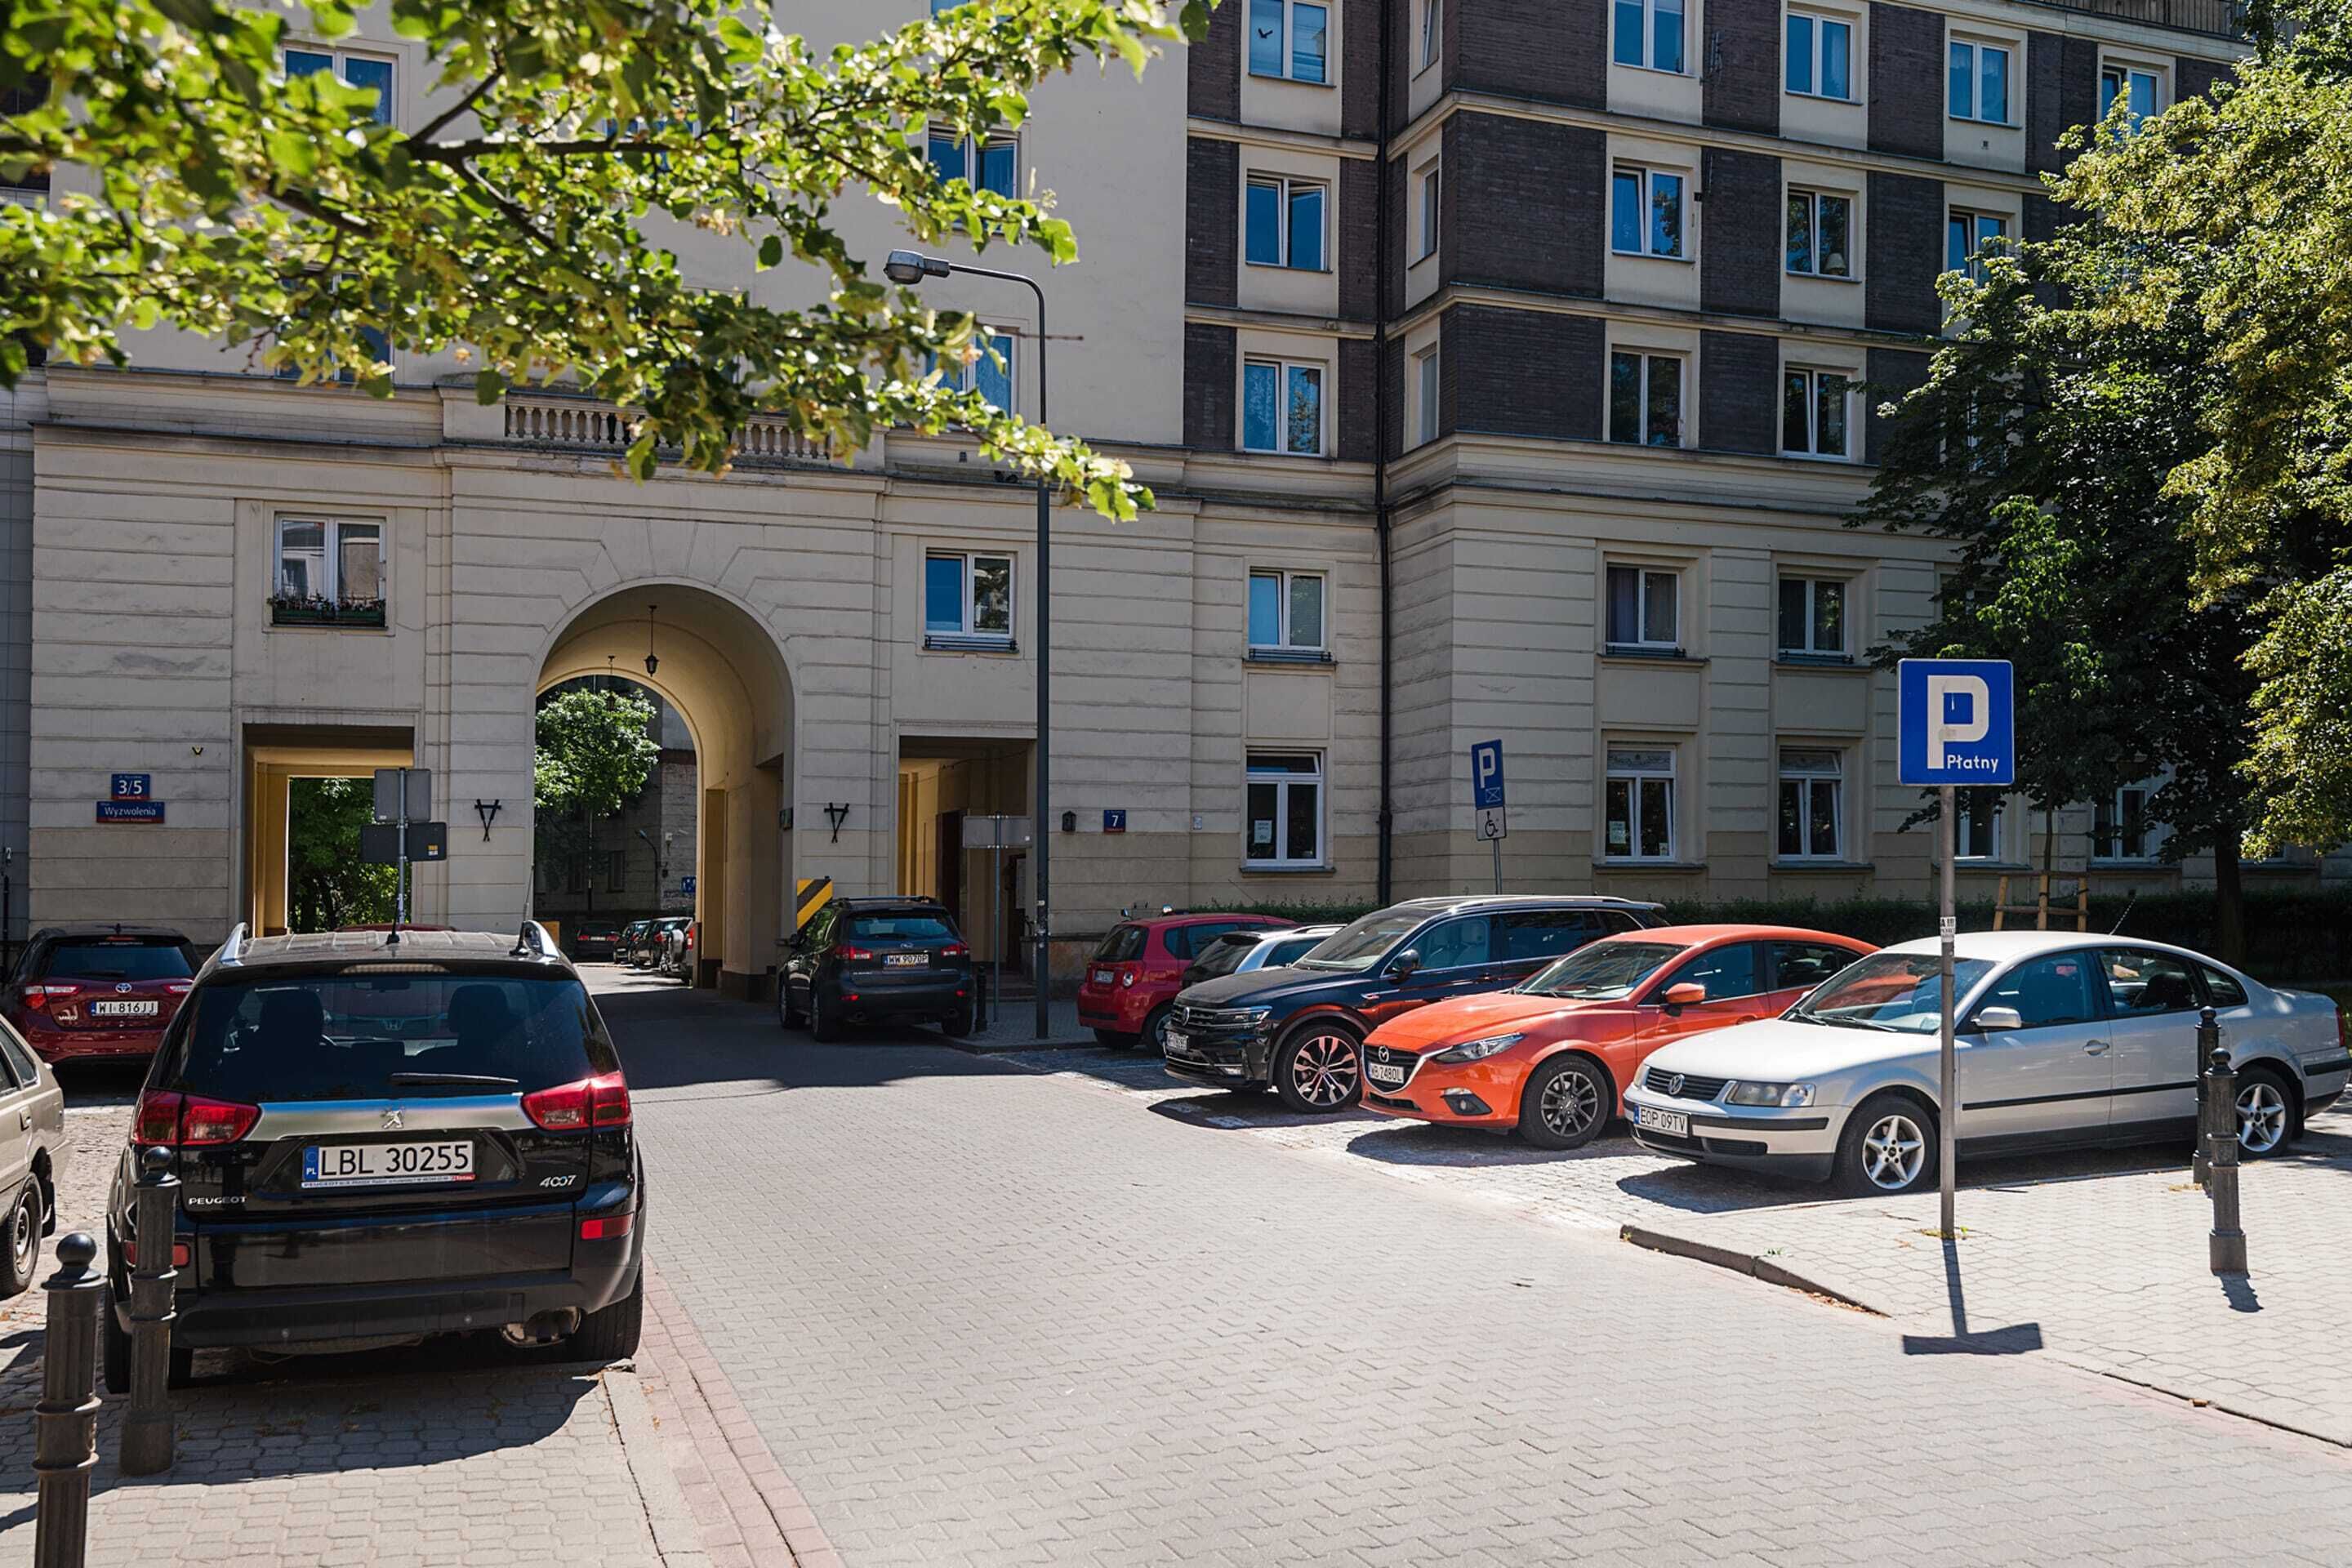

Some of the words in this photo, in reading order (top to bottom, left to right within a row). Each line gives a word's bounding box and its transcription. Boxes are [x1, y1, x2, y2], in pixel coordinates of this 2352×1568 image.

[1927, 675, 1989, 769] P
[1478, 747, 1496, 789] P
[1947, 755, 1998, 773] Płatny
[118, 780, 143, 795] 3/5
[104, 806, 156, 817] Wyzwolenia
[1111, 815, 1119, 826] 7
[99, 1003, 113, 1013] WI
[118, 1003, 154, 1013] 816JJ
[1641, 1107, 1659, 1125] EOP
[1660, 1112, 1685, 1131] 09TV
[321, 1149, 374, 1176] LBL
[385, 1145, 468, 1173] 30255
[540, 1174, 577, 1187] 4007
[189, 1196, 248, 1205] PEUGEOT
